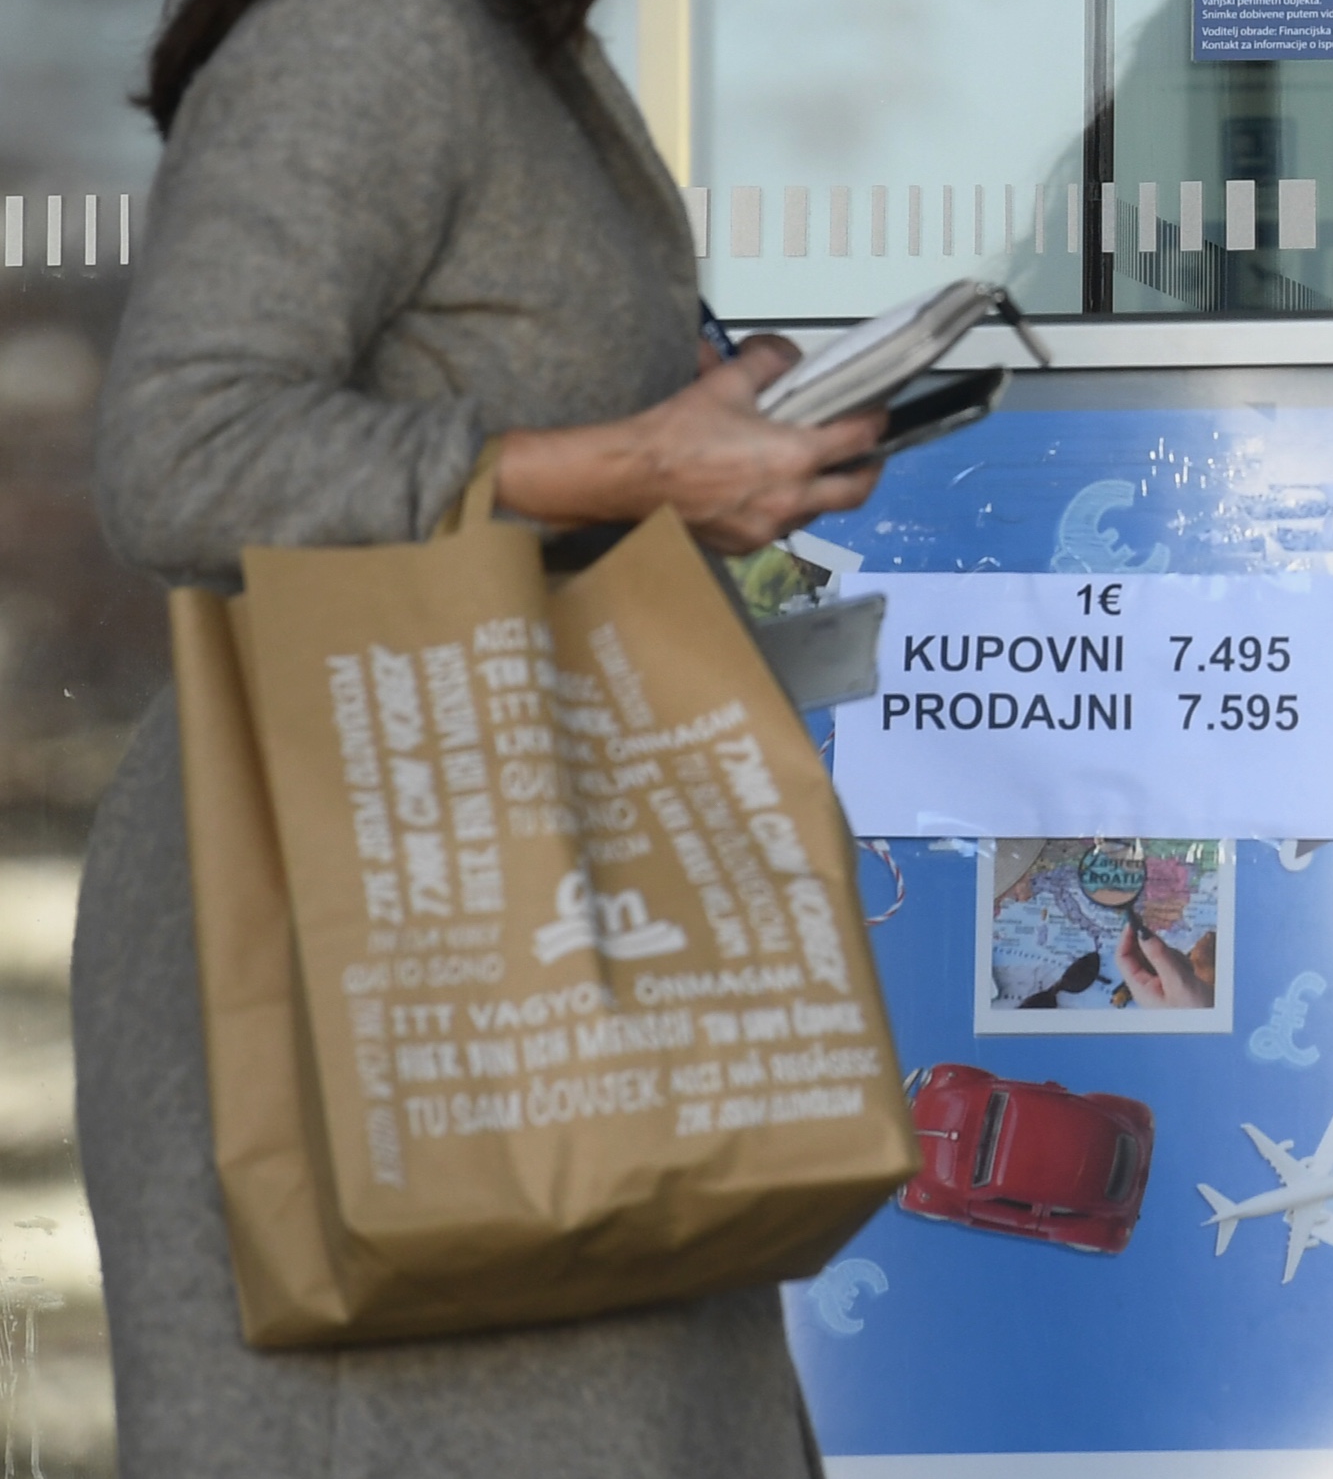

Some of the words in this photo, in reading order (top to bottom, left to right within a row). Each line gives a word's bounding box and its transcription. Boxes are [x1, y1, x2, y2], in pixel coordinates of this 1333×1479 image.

[1201, 25, 1238, 38] Voditelj
[1240, 25, 1277, 35] obrade:
[1278, 25, 1331, 37] Financijska
[1076, 583, 1123, 616] 1€
[903, 635, 1124, 673] KUPOVNI
[1169, 636, 1291, 673] 7.495
[882, 692, 1133, 731] PRODAJNI
[1178, 694, 1300, 731] 7.595
